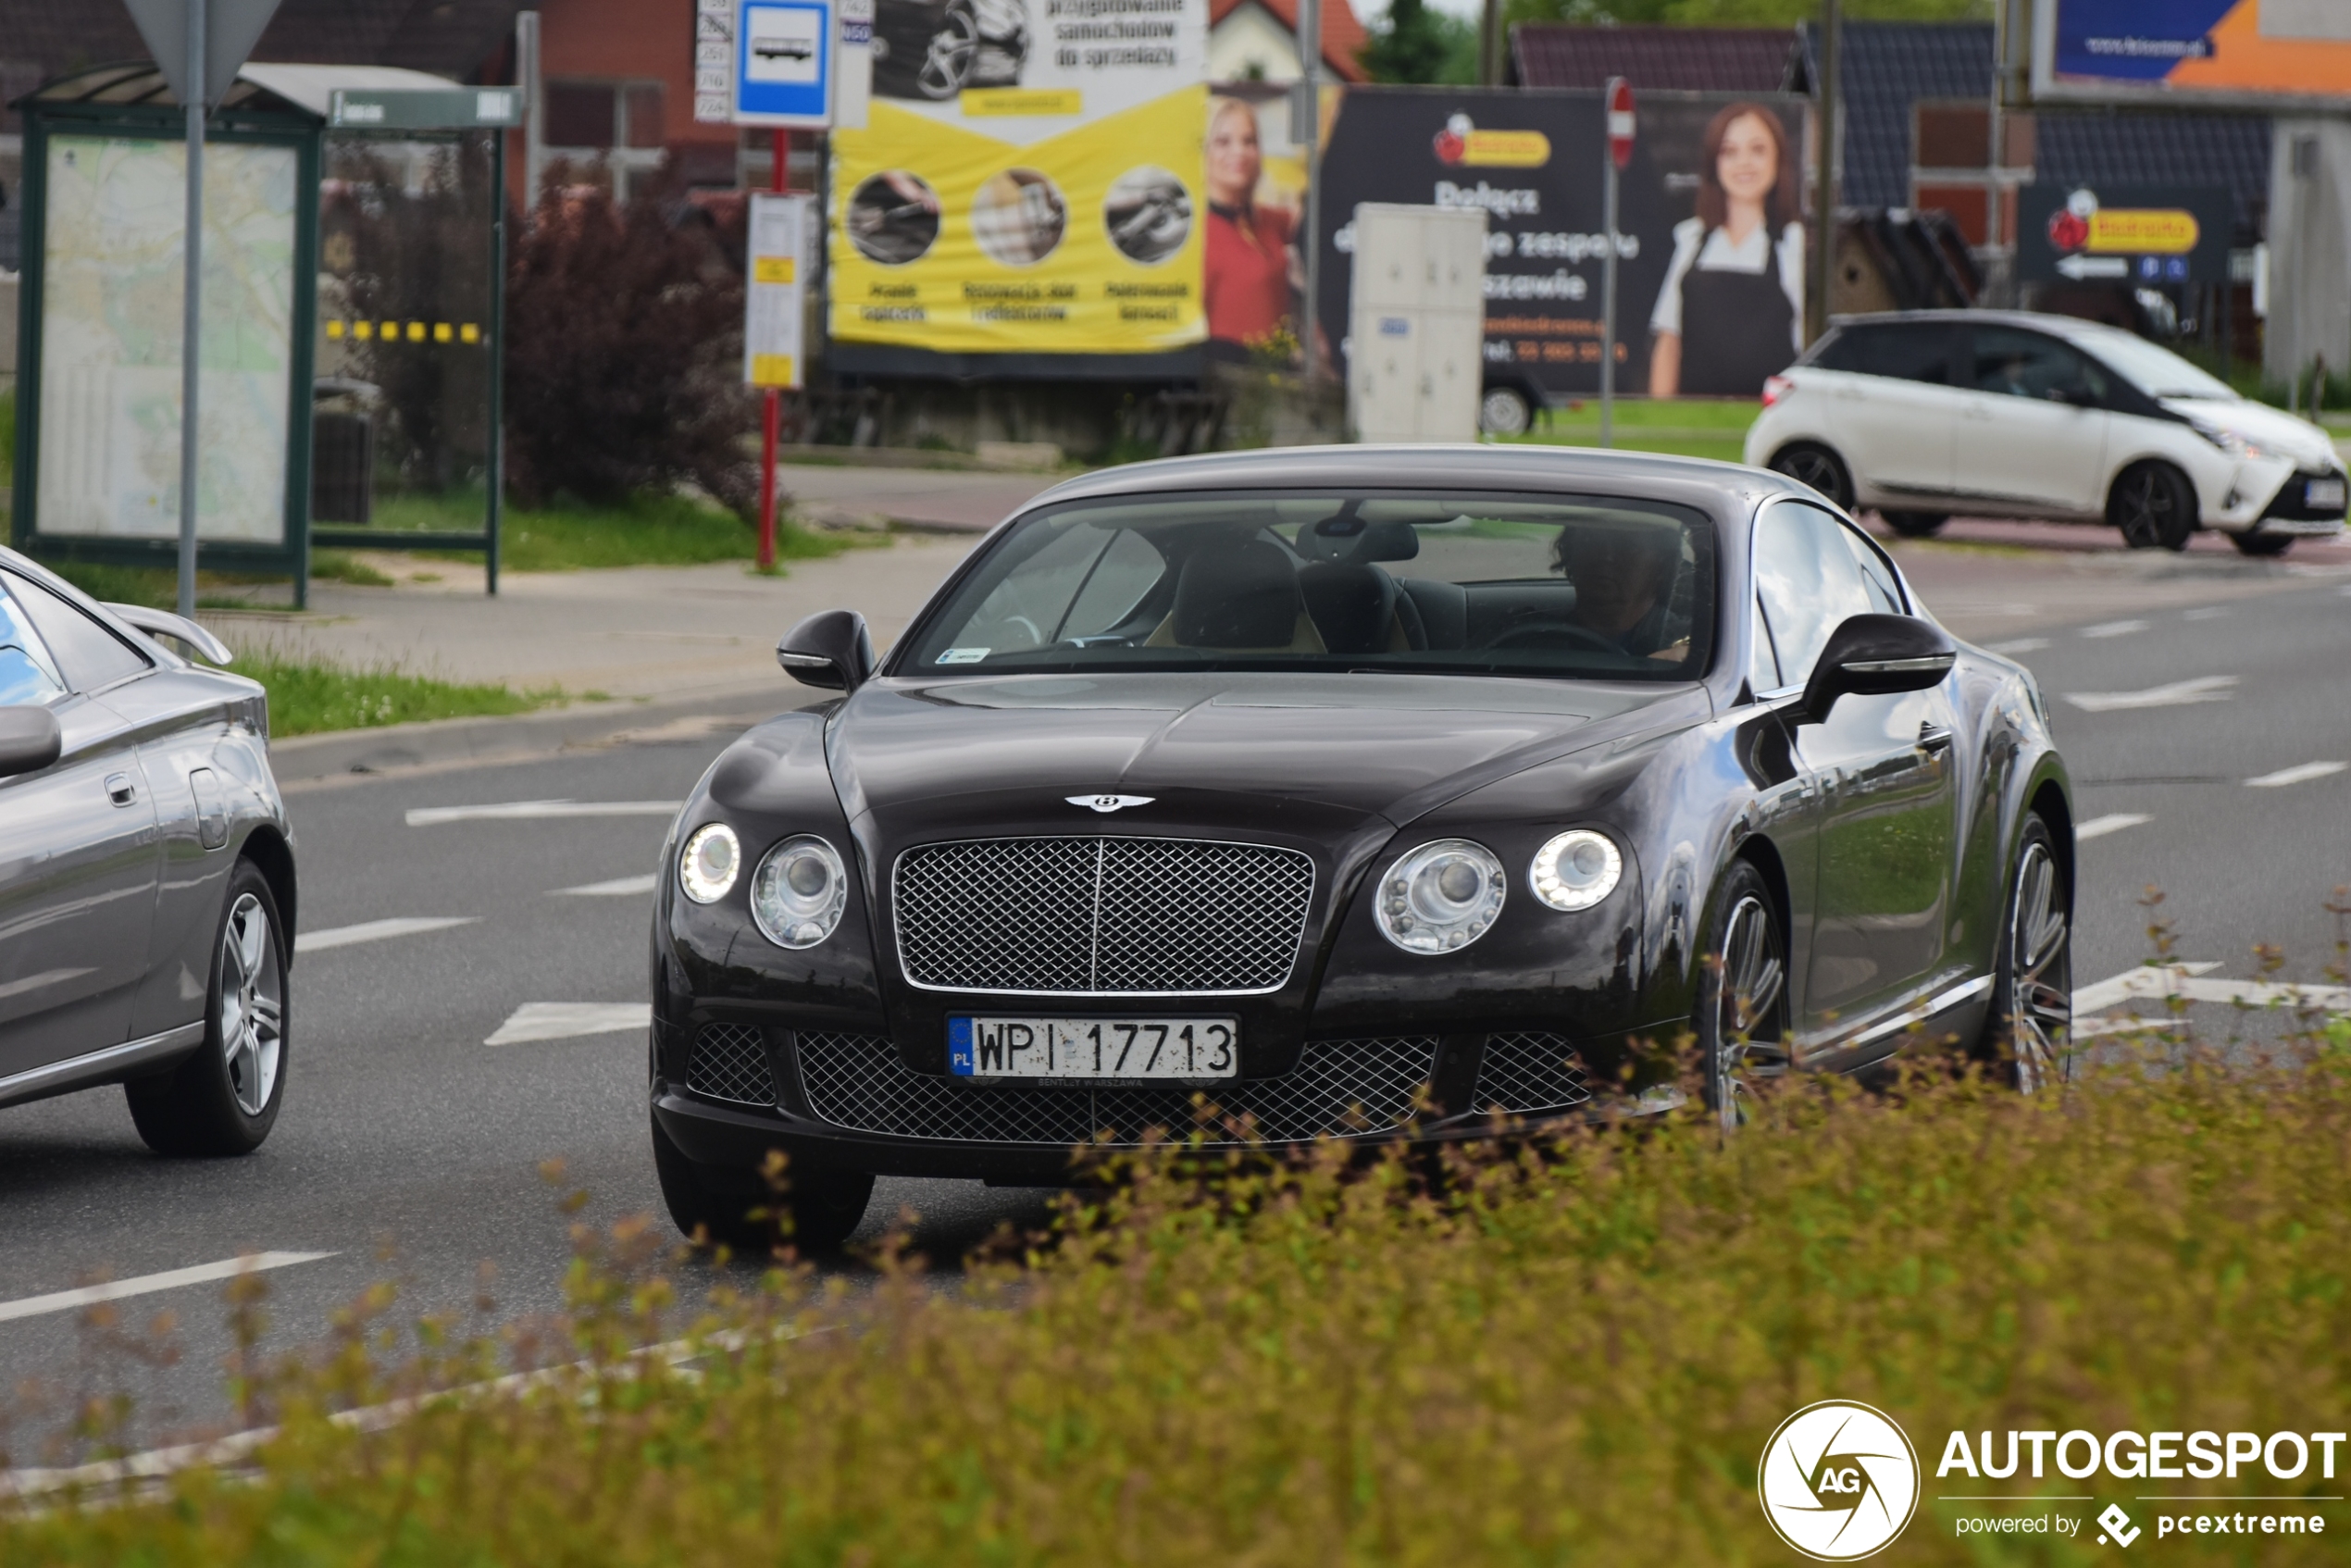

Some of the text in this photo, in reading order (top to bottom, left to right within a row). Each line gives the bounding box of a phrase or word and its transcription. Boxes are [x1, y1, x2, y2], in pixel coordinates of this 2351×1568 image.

[1087, 1024, 1232, 1072] 17713
[953, 1053, 971, 1067] PL
[1038, 1077, 1143, 1088] BENTLEY WARSZAWA
